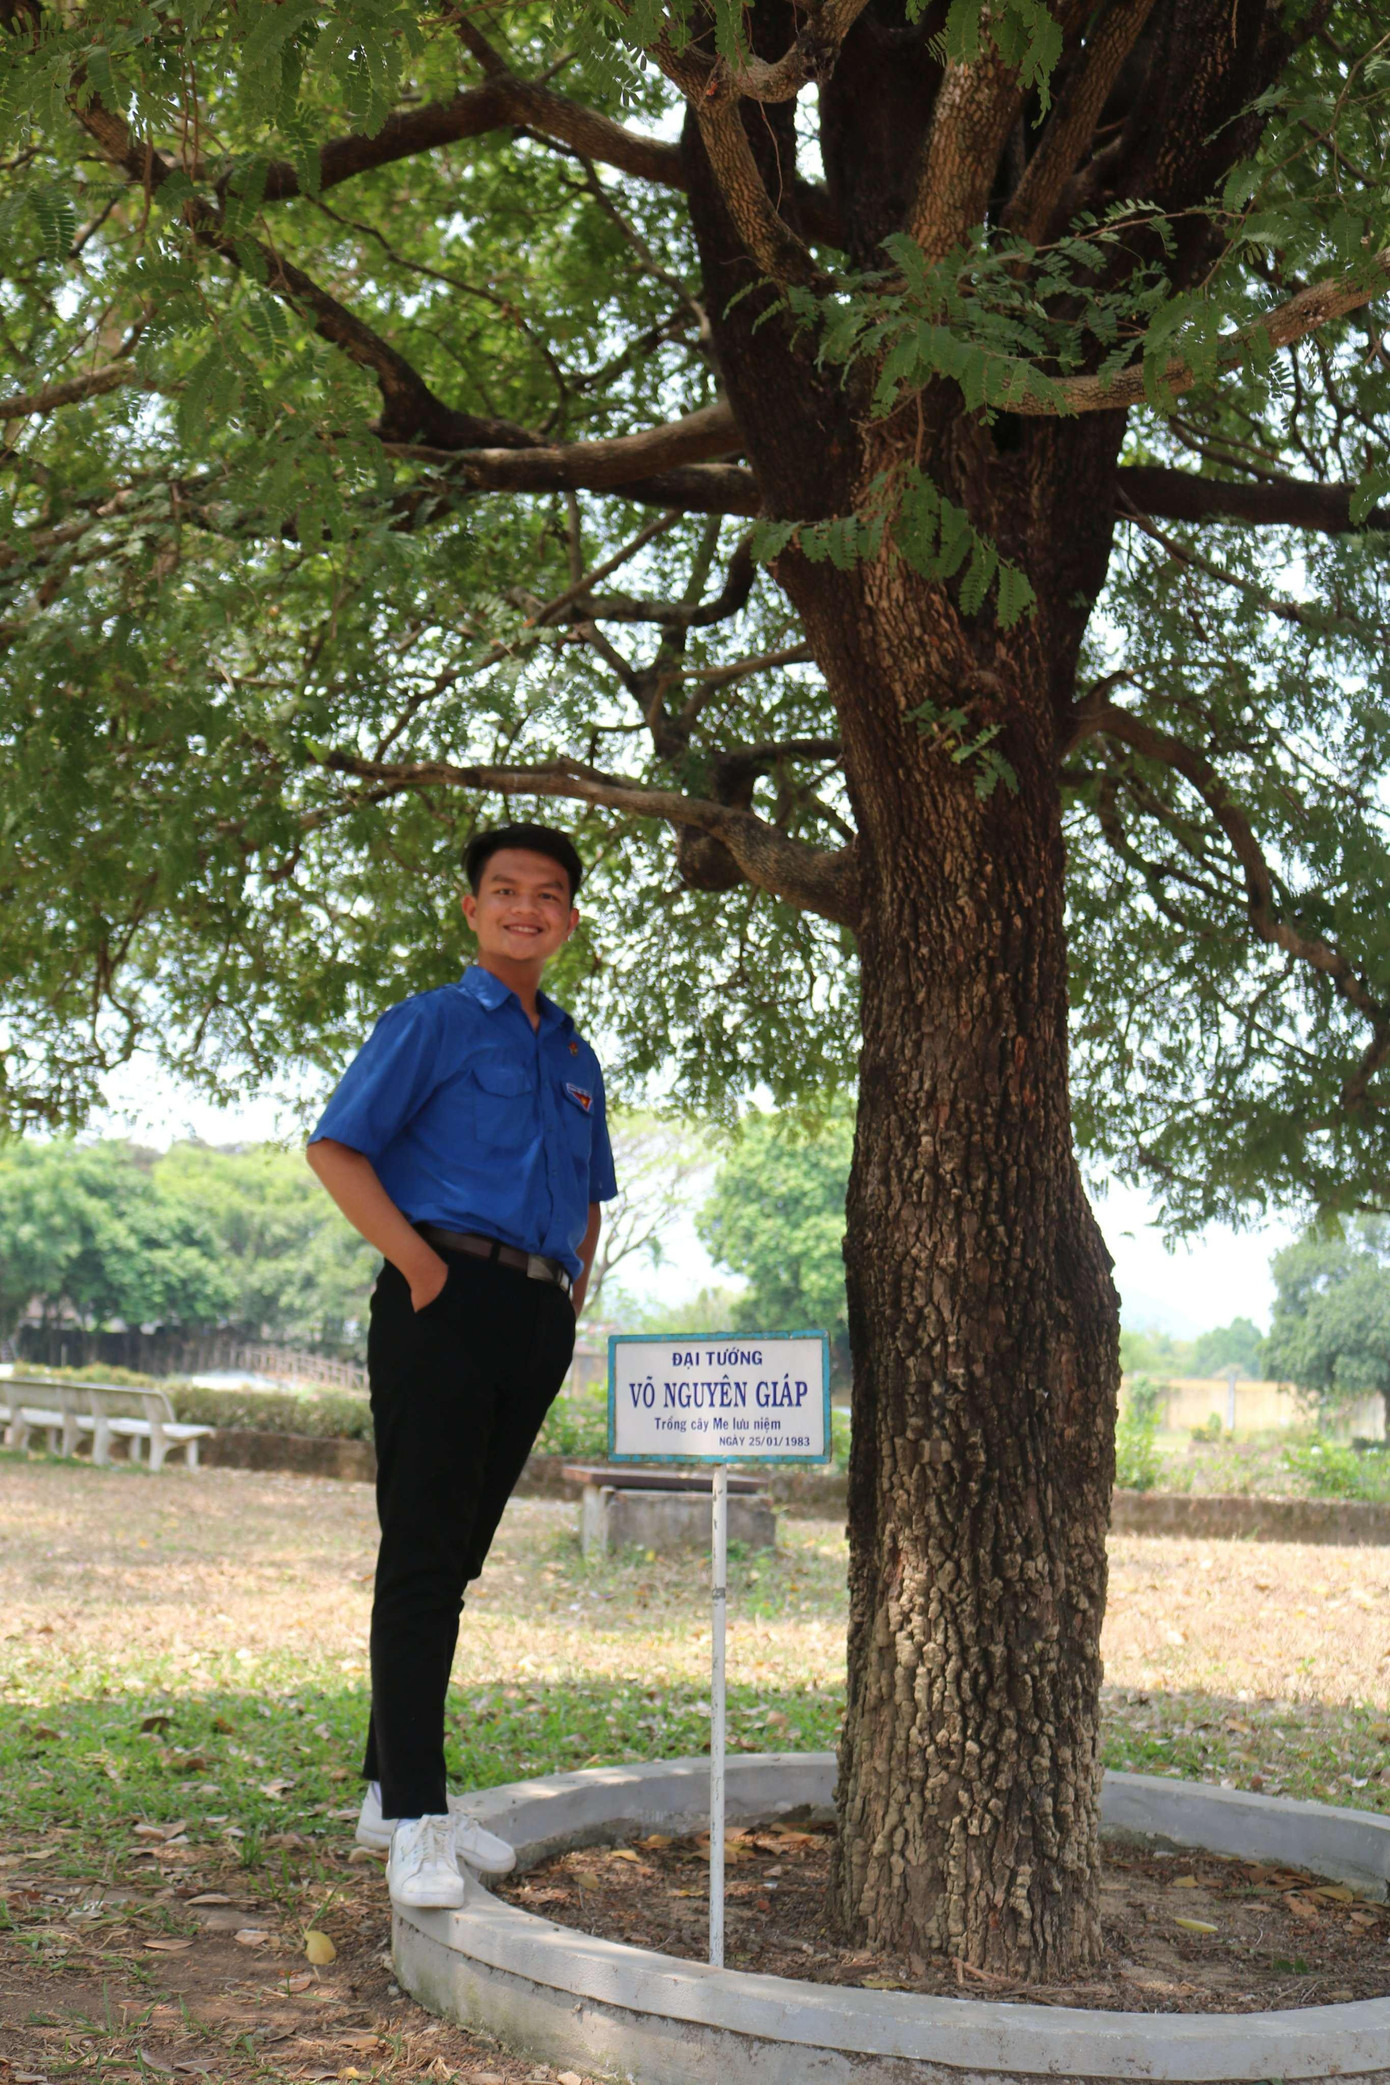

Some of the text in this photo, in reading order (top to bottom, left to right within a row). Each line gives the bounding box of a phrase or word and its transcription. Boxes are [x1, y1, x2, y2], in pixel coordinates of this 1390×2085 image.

[672, 1346, 763, 1370] ĐẠI TƯỚNG
[628, 1373, 809, 1409] VÕ NGUYÊN GIÁP
[653, 1415, 782, 1434] Trồng cây Me lưu niệm
[719, 1434, 811, 1448] NGÀY 25/01/1983
